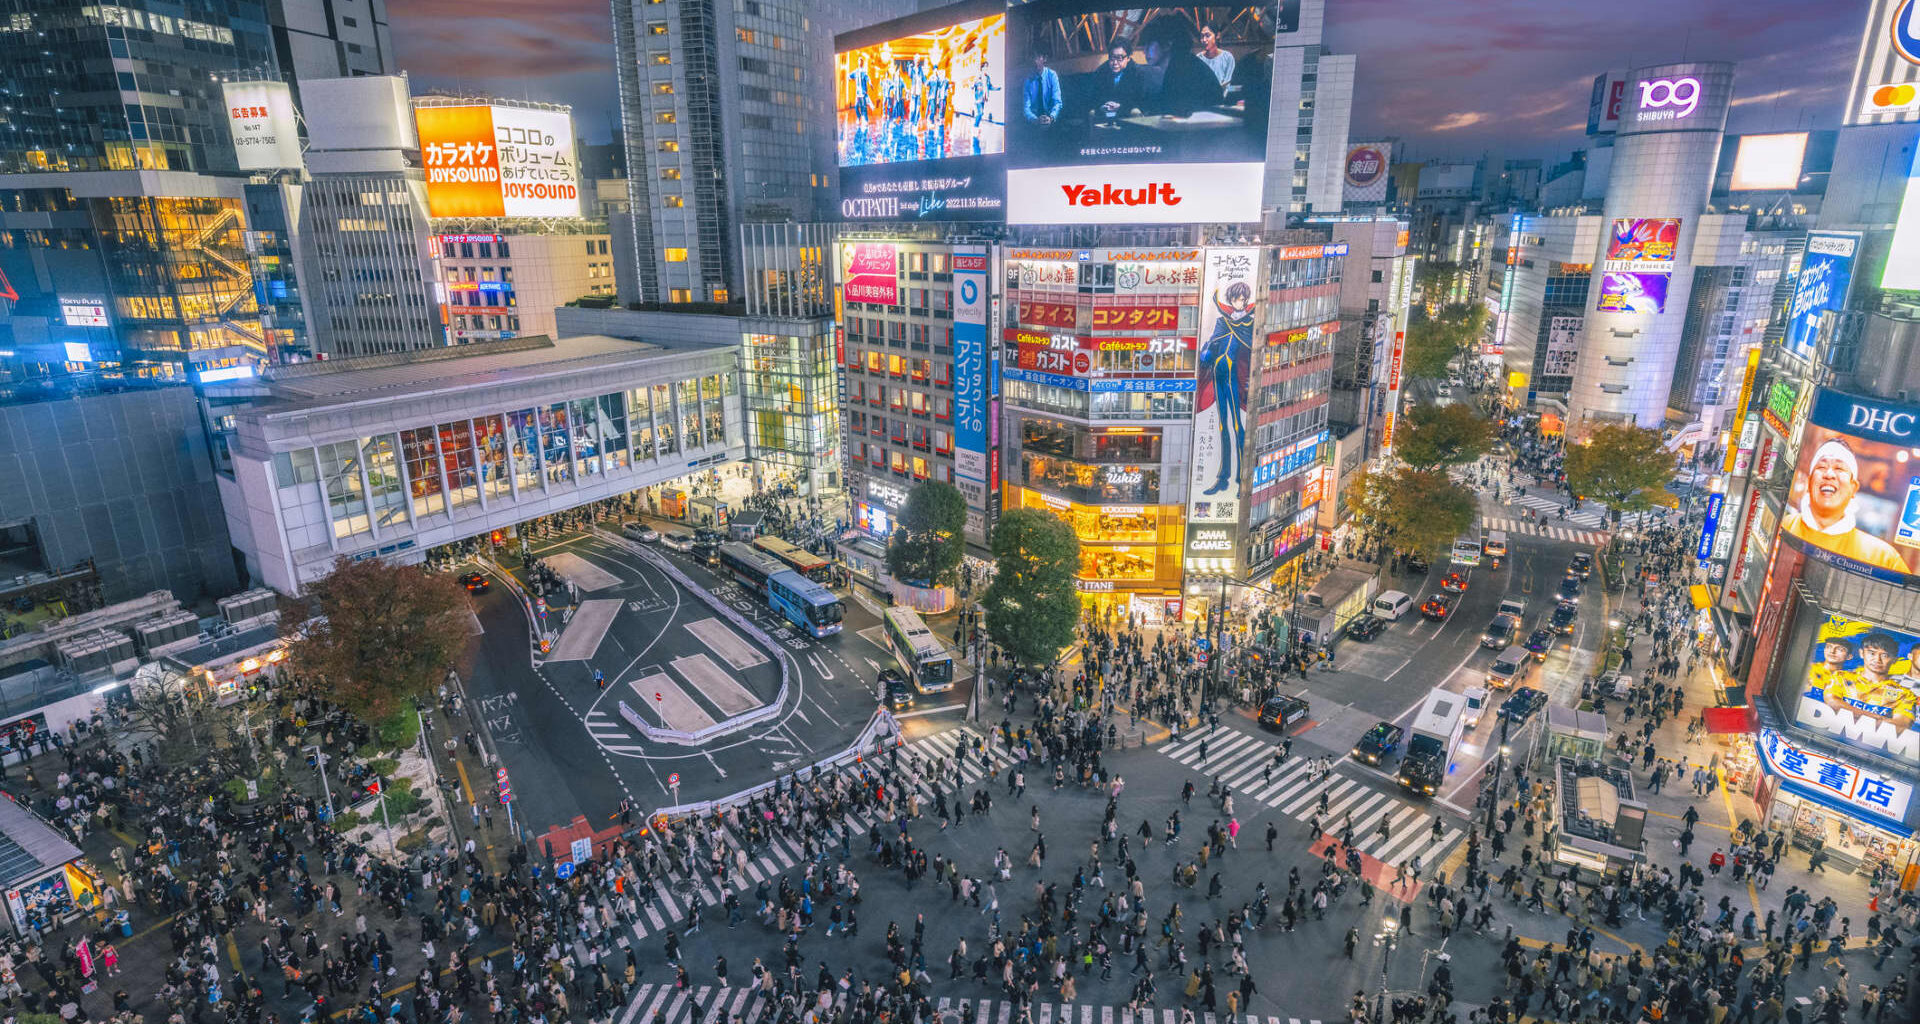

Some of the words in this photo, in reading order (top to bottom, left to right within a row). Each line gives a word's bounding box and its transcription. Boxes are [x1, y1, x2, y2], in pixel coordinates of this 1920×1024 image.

[1640, 78, 1700, 118] 109
[232, 107, 268, 119] 広告募集
[1638, 111, 1674, 121] SHIBUYA
[497, 126, 555, 146] ココロの
[426, 142, 493, 165] カラオケ
[500, 147, 573, 166] ボリューム、
[430, 167, 497, 183] JOYSOUND
[504, 183, 576, 199] JOYSOUND
[1061, 183, 1182, 206] Yakult
[842, 197, 898, 217] OCTPATH
[919, 191, 944, 217] Like
[977, 199, 1000, 207] Release
[1108, 251, 1199, 261] しゃぶしゃぶバイキング
[1008, 269, 1019, 279] 9F
[1607, 261, 1632, 270] 11.18
[1040, 267, 1075, 284] しゃぶ葉
[1145, 267, 1198, 285] しゃぶ葉
[851, 285, 893, 299] 品川美容外科
[1094, 309, 1176, 325] コンタクト
[1051, 334, 1079, 351] ガスト
[1149, 338, 1188, 353] ガスト
[1006, 349, 1019, 360] 7F
[1036, 351, 1070, 371] ガスト
[957, 340, 971, 430] アイシティ
[973, 341, 983, 433] コンタクトの
[1124, 381, 1194, 391] 英会話イーオン
[1848, 404, 1915, 437] DHC
[1296, 506, 1315, 527] LUSH
[1197, 531, 1227, 540] DMM
[1190, 541, 1232, 550] GAMES
[1837, 557, 1873, 575] Channel
